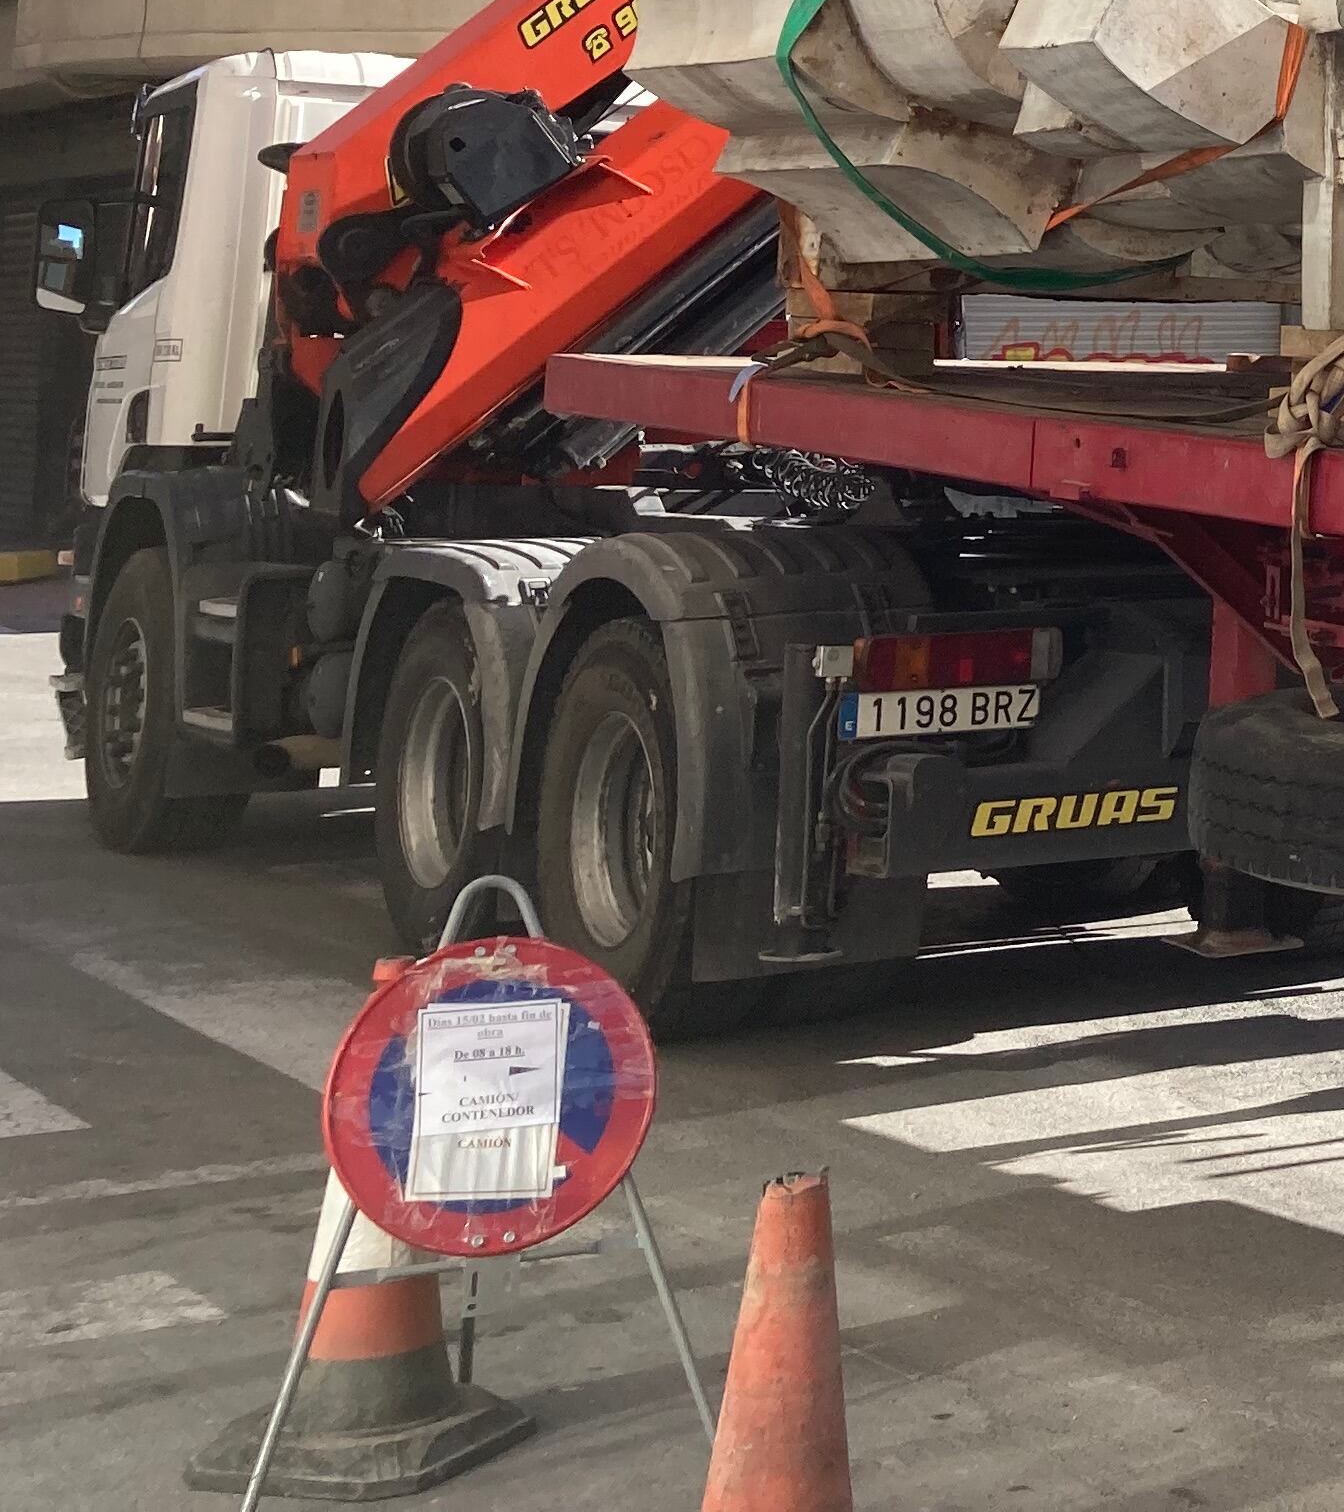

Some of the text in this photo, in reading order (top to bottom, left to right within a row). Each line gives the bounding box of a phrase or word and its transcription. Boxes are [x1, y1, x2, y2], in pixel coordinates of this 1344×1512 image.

[873, 688, 1037, 732] 1198 BRZ
[971, 787, 1178, 836] GRUAS
[521, 1010, 536, 1020] fin
[541, 1009, 553, 1019] de
[454, 1050, 470, 1059] De
[472, 1048, 486, 1058] 08
[499, 1047, 512, 1056] 18
[442, 1105, 536, 1123] CONTENEDOR
